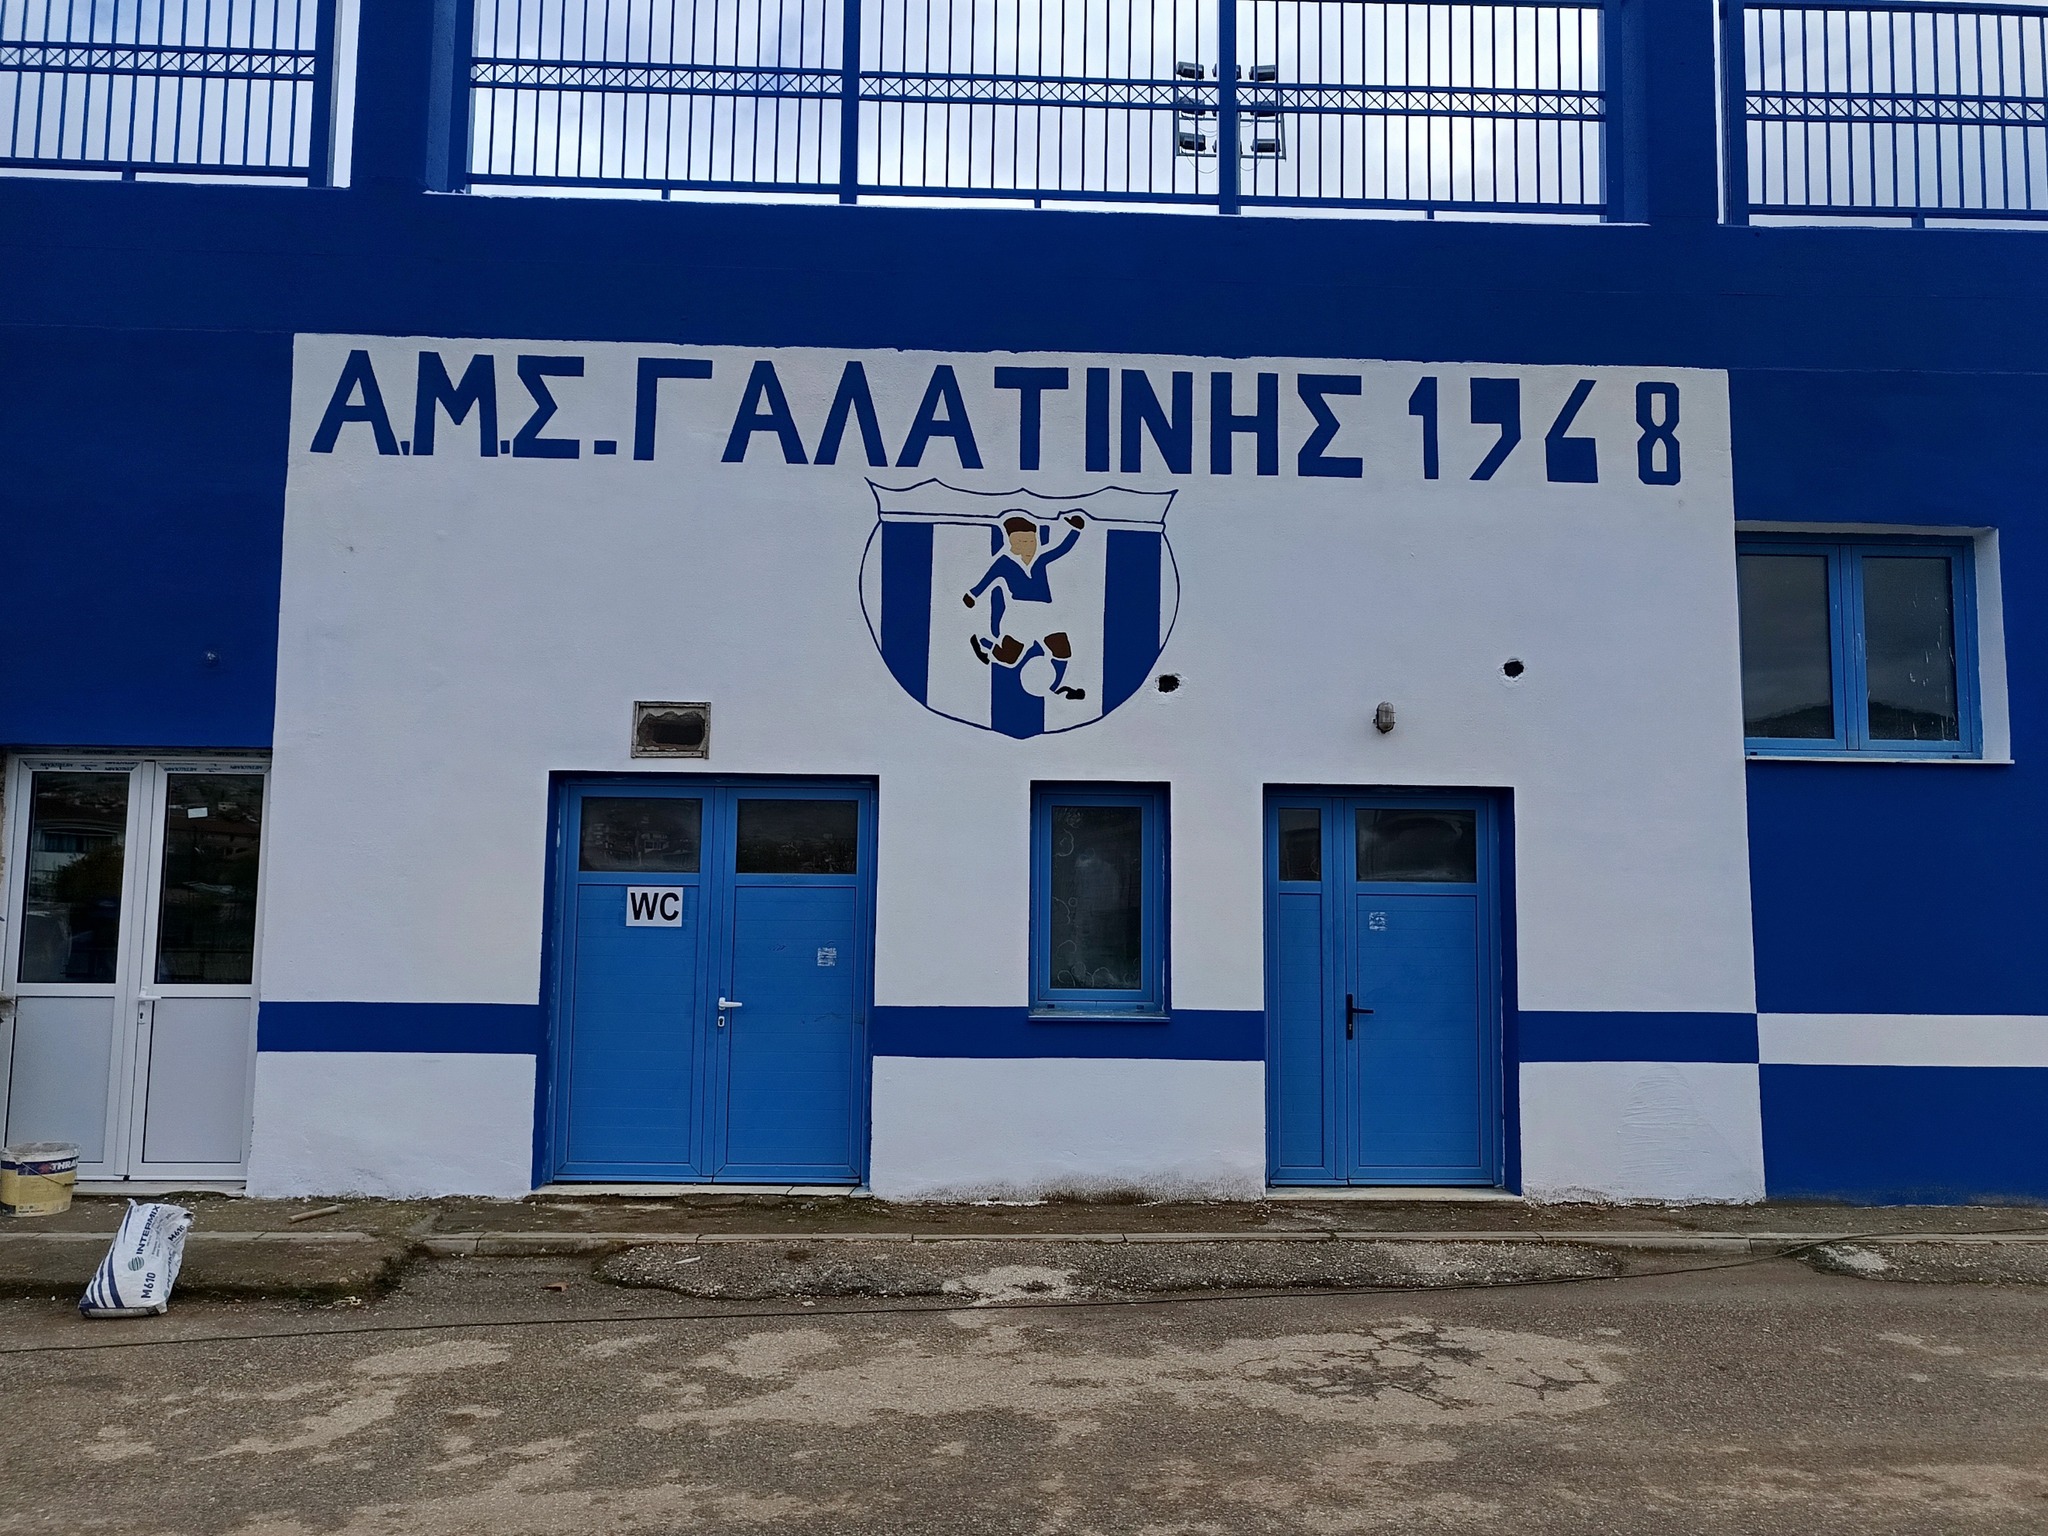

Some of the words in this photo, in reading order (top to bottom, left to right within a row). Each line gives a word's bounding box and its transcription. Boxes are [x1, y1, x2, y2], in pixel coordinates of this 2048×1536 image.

[634, 358, 1363, 478] ΓΑΛΑΤΙΝΗΣ
[630, 891, 680, 921] WC
[136, 1205, 160, 1255] INTERMIX
[141, 1272, 156, 1299] M610
